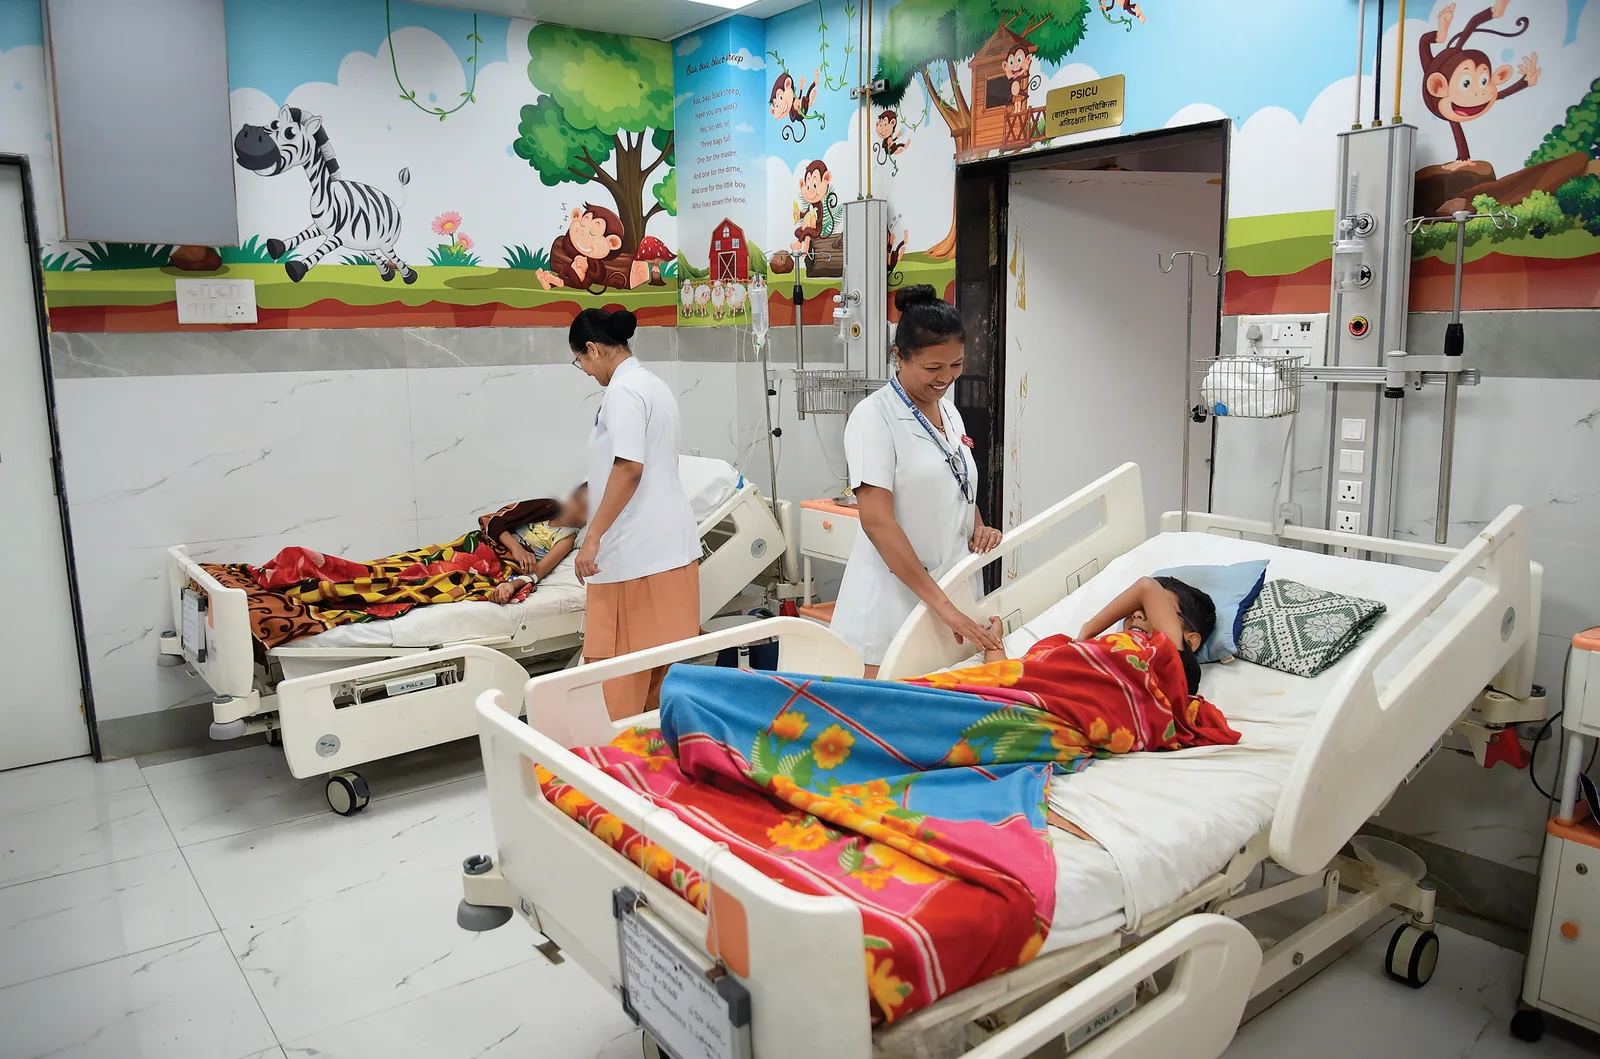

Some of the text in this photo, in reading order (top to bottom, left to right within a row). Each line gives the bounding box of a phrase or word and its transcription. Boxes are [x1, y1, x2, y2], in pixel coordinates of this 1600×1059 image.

[1070, 85, 1099, 101] PSICU
[695, 111, 705, 119] Have
[706, 109, 714, 118] you
[712, 137, 722, 146] bags
[696, 157, 705, 165] One
[712, 153, 720, 161] the
[693, 172, 702, 180] And
[702, 170, 710, 178] one
[717, 166, 725, 174] the
[691, 187, 700, 195] And
[700, 186, 708, 194] one
[715, 182, 723, 190] the
[724, 180, 734, 189] little
[734, 179, 747, 190] boy
[691, 202, 701, 210] Who
[701, 200, 711, 208] lives
[711, 198, 724, 207] down
[724, 196, 732, 205] the
